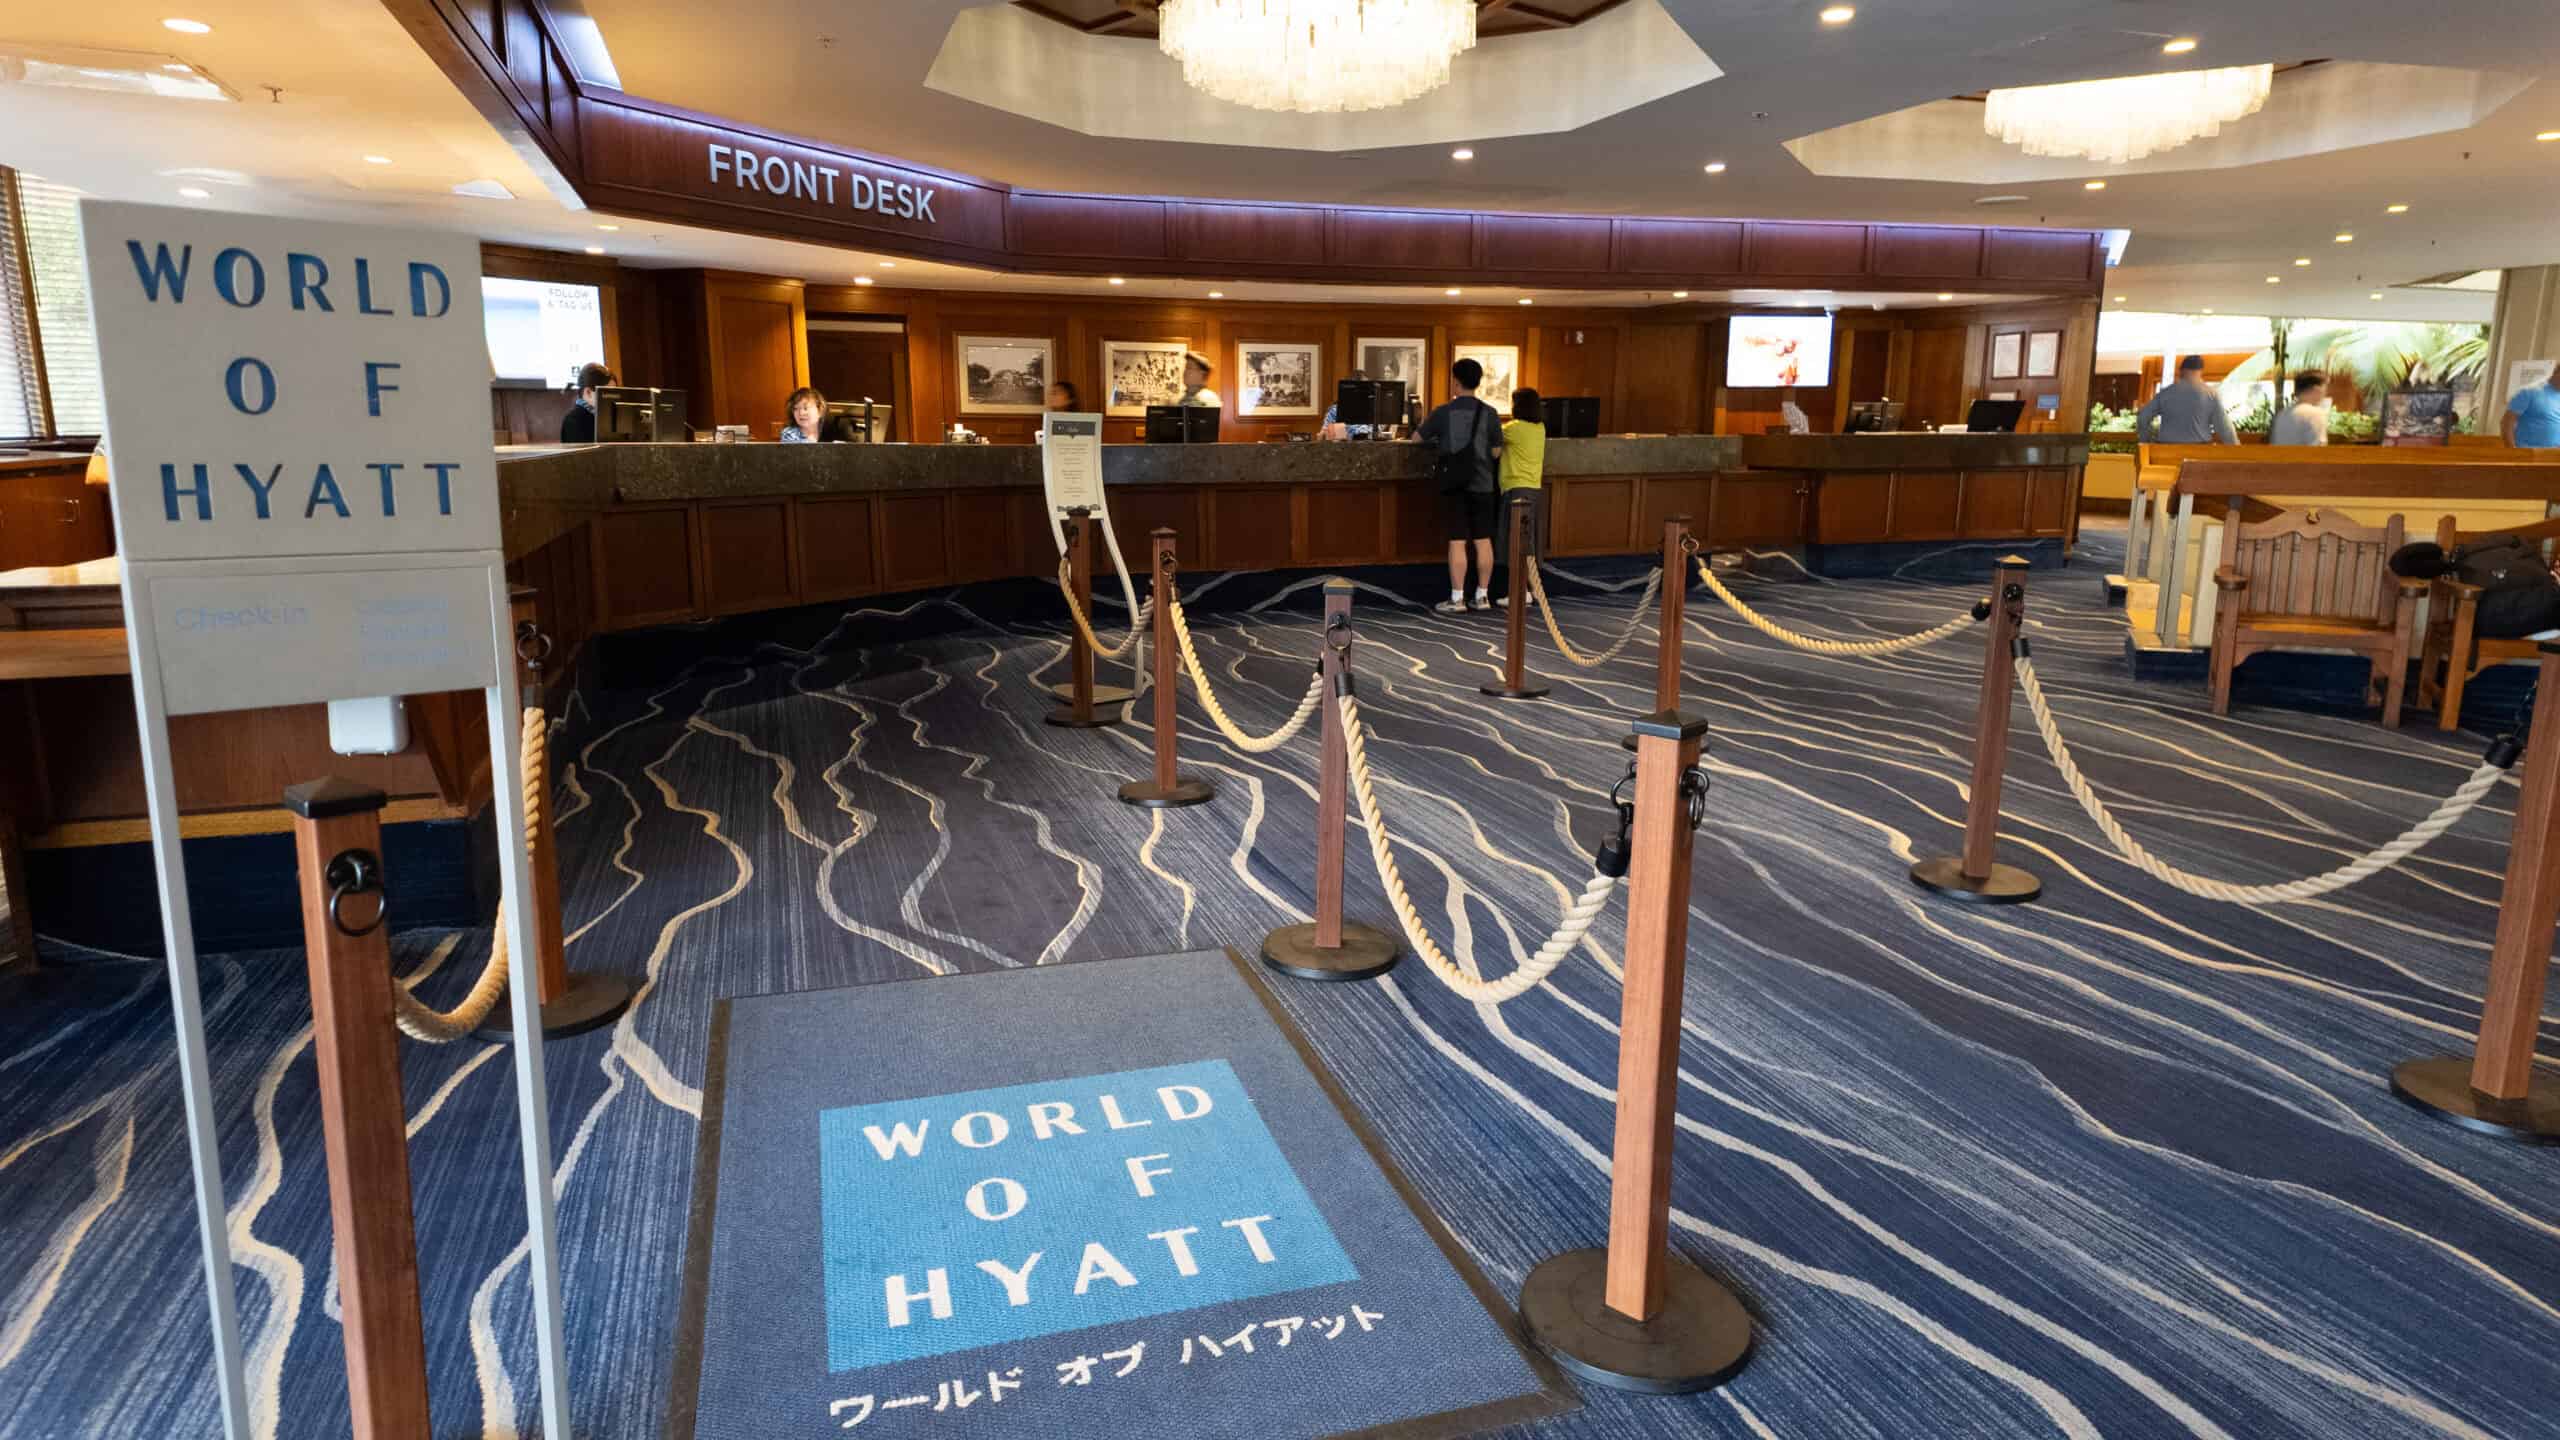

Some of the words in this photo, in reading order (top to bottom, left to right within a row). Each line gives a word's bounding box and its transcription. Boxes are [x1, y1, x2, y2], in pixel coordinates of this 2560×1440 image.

[708, 143, 840, 204] FRONT
[851, 174, 936, 223] DESK
[127, 239, 451, 319] WORLD
[224, 356, 402, 416] OF
[160, 463, 461, 521] HYATT
[174, 603, 308, 632] Check-in
[863, 1084, 1213, 1161] WORLD
[965, 1153, 1174, 1222] OF
[884, 1214, 1277, 1329] HYATT
[829, 1367, 1022, 1429] ワールド
[1056, 1341, 1146, 1387] オブ
[1180, 1304, 1385, 1365] ハイアット
